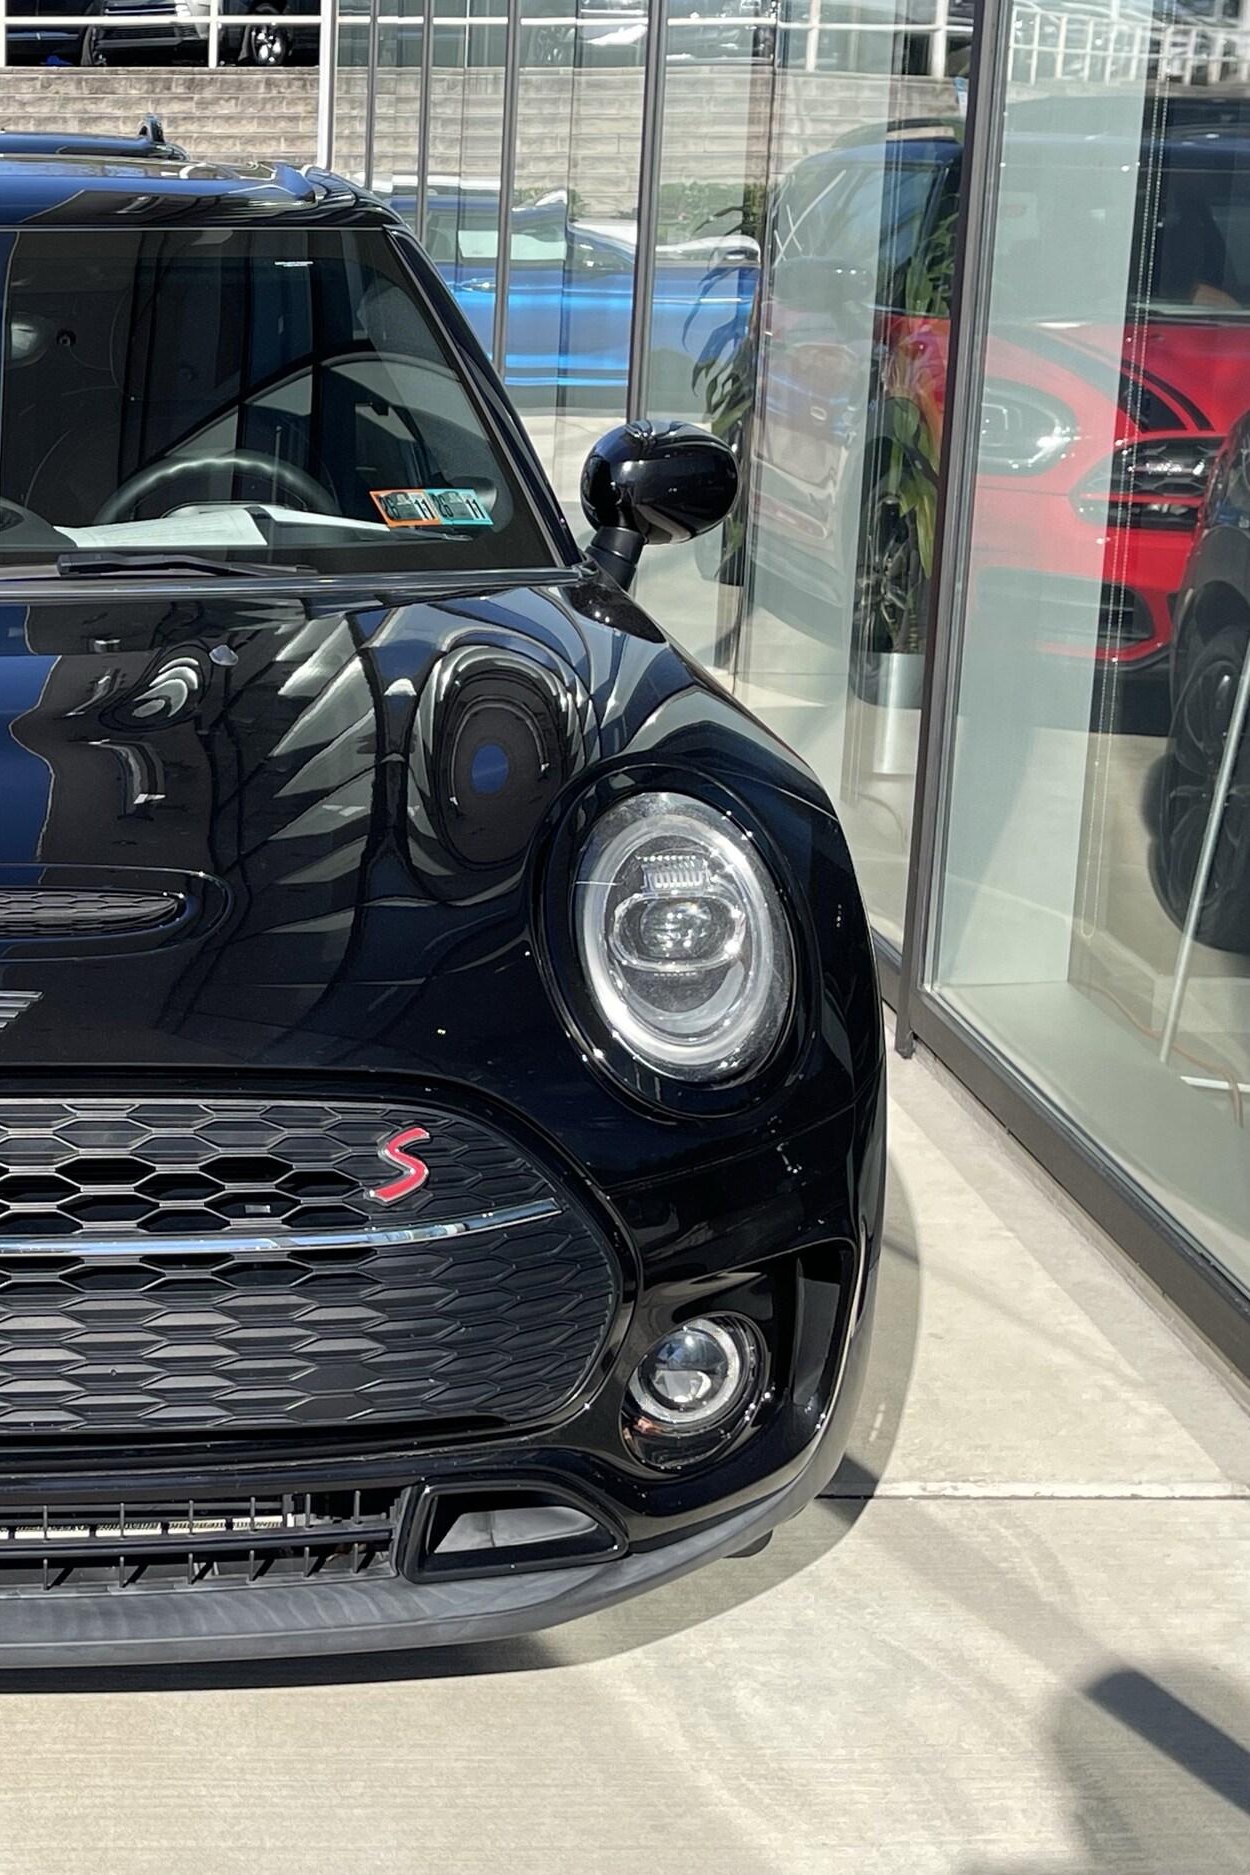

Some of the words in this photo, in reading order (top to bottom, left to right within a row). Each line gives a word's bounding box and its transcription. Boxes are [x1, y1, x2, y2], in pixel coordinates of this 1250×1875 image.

[414, 499, 435, 520] 11
[432, 495, 454, 518] 26
[465, 499, 486, 519] 11
[367, 1126, 431, 1203] S
